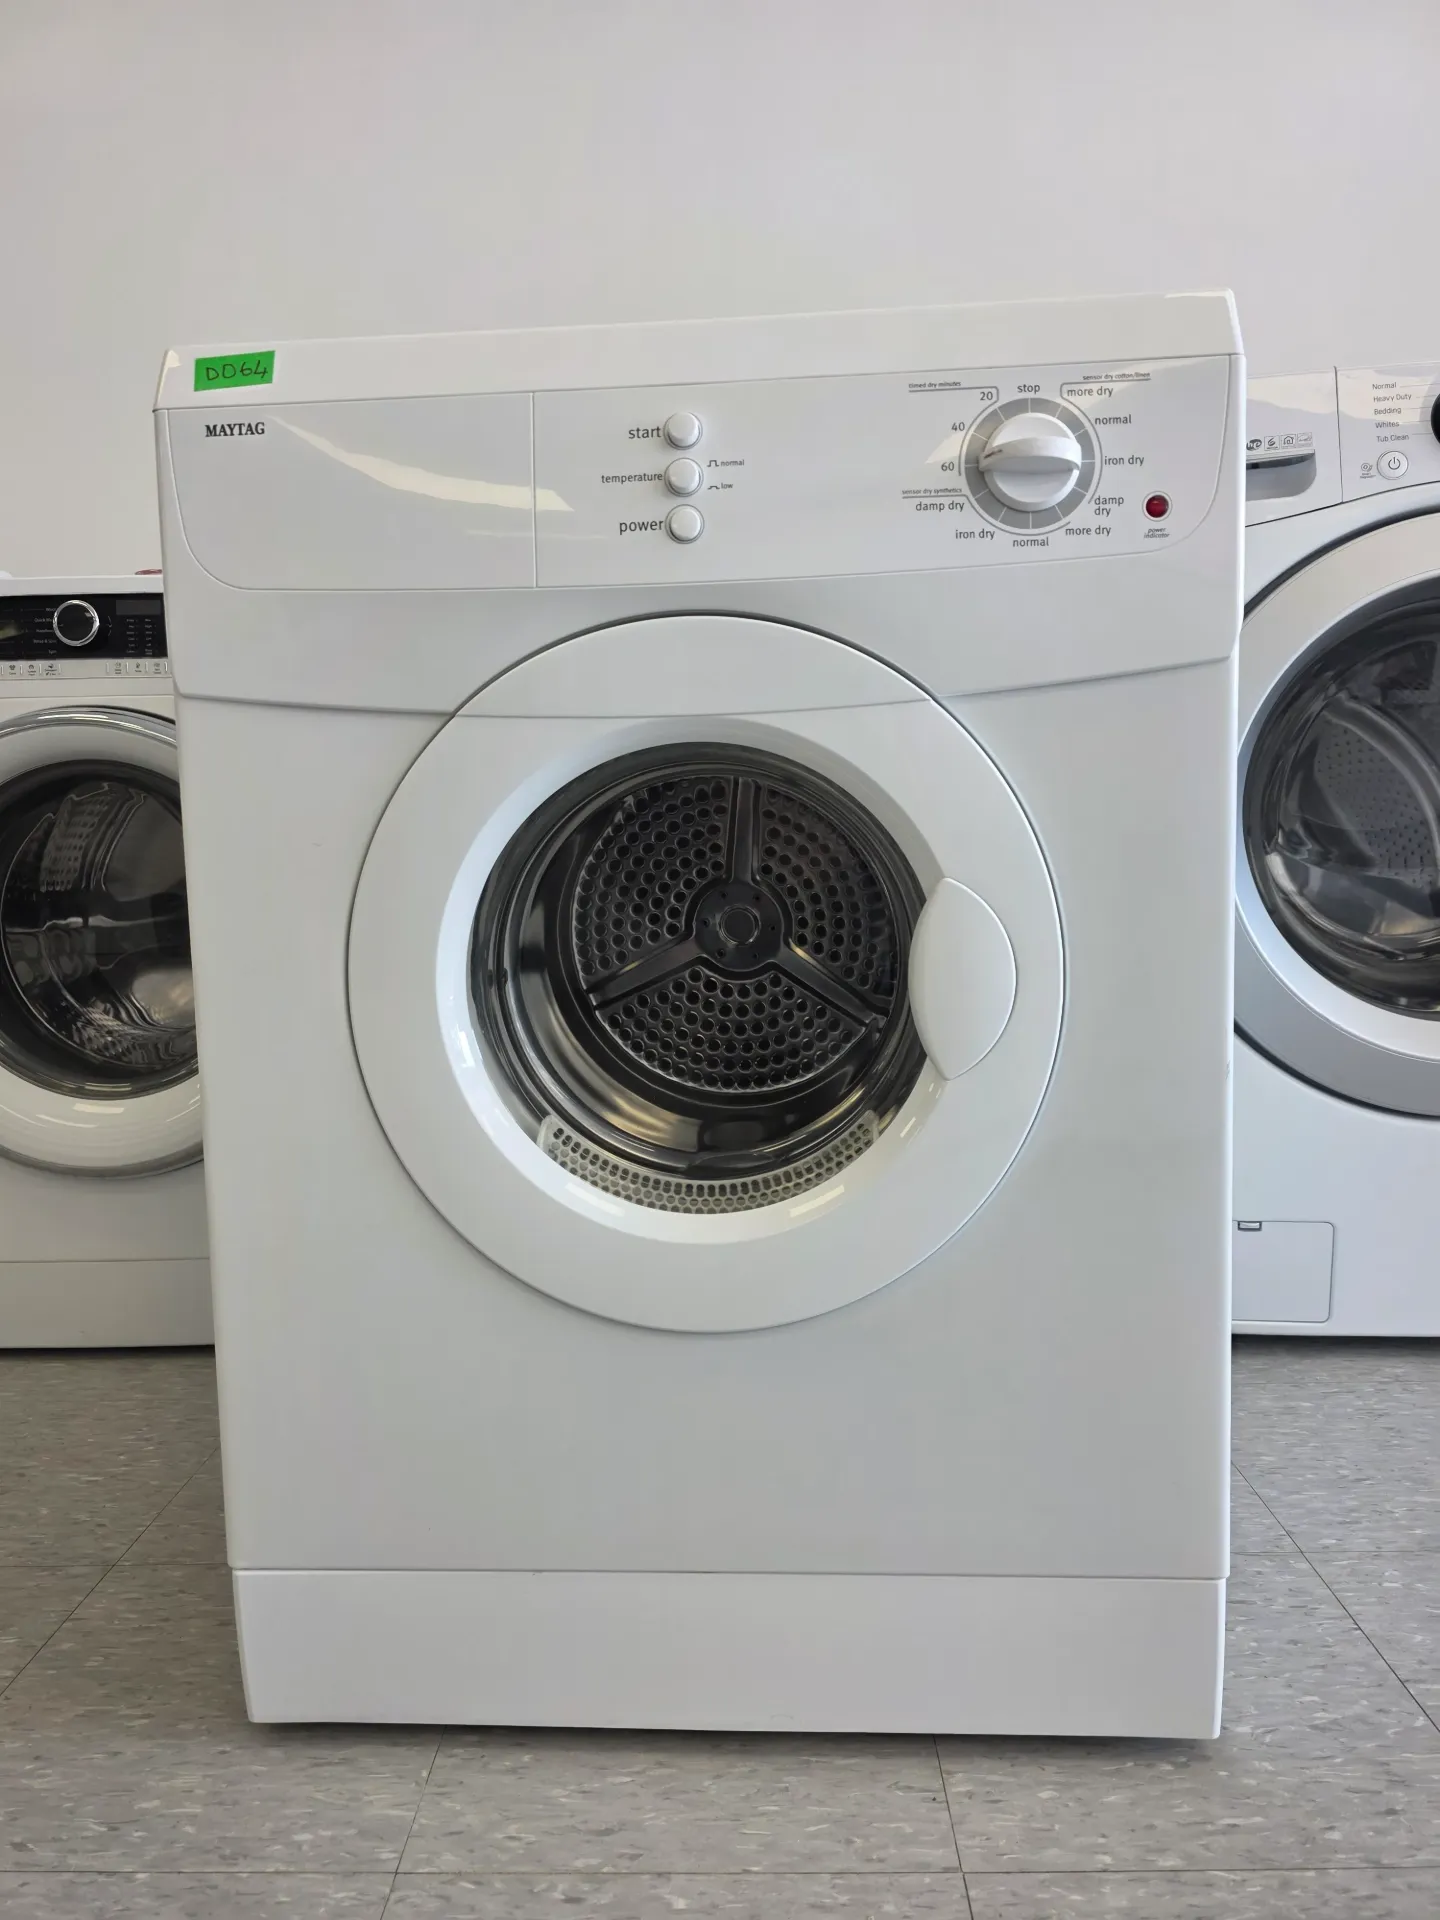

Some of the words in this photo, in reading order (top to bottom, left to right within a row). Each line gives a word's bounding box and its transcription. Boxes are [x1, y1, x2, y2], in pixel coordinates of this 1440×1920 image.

[1017, 383, 1041, 394] stop
[1067, 388, 1094, 396] more
[1097, 386, 1114, 398] dry
[1372, 382, 1397, 390] Normal
[980, 391, 994, 401] 20
[1373, 394, 1395, 402] Heavy
[1396, 394, 1412, 402] Duty
[1374, 406, 1402, 415] Bedding
[1094, 414, 1132, 426] normal
[1375, 421, 1400, 429] Whites
[205, 422, 266, 438] MAYTAG
[628, 426, 662, 440] start
[951, 422, 966, 432] 40
[1390, 434, 1410, 442] Clean
[720, 459, 745, 467] normal
[940, 462, 955, 472] 60
[1104, 456, 1125, 466] iron
[1128, 454, 1145, 468] dry
[601, 472, 663, 484] temperature
[915, 501, 945, 512] damp
[948, 500, 965, 512] dry
[1094, 495, 1125, 507] damp
[1094, 505, 1112, 518] dry
[619, 520, 664, 535] power
[1064, 527, 1092, 537] more
[1094, 525, 1112, 538] dry
[955, 529, 976, 540] iron
[978, 528, 996, 542] dry
[1012, 536, 1050, 548] normal
